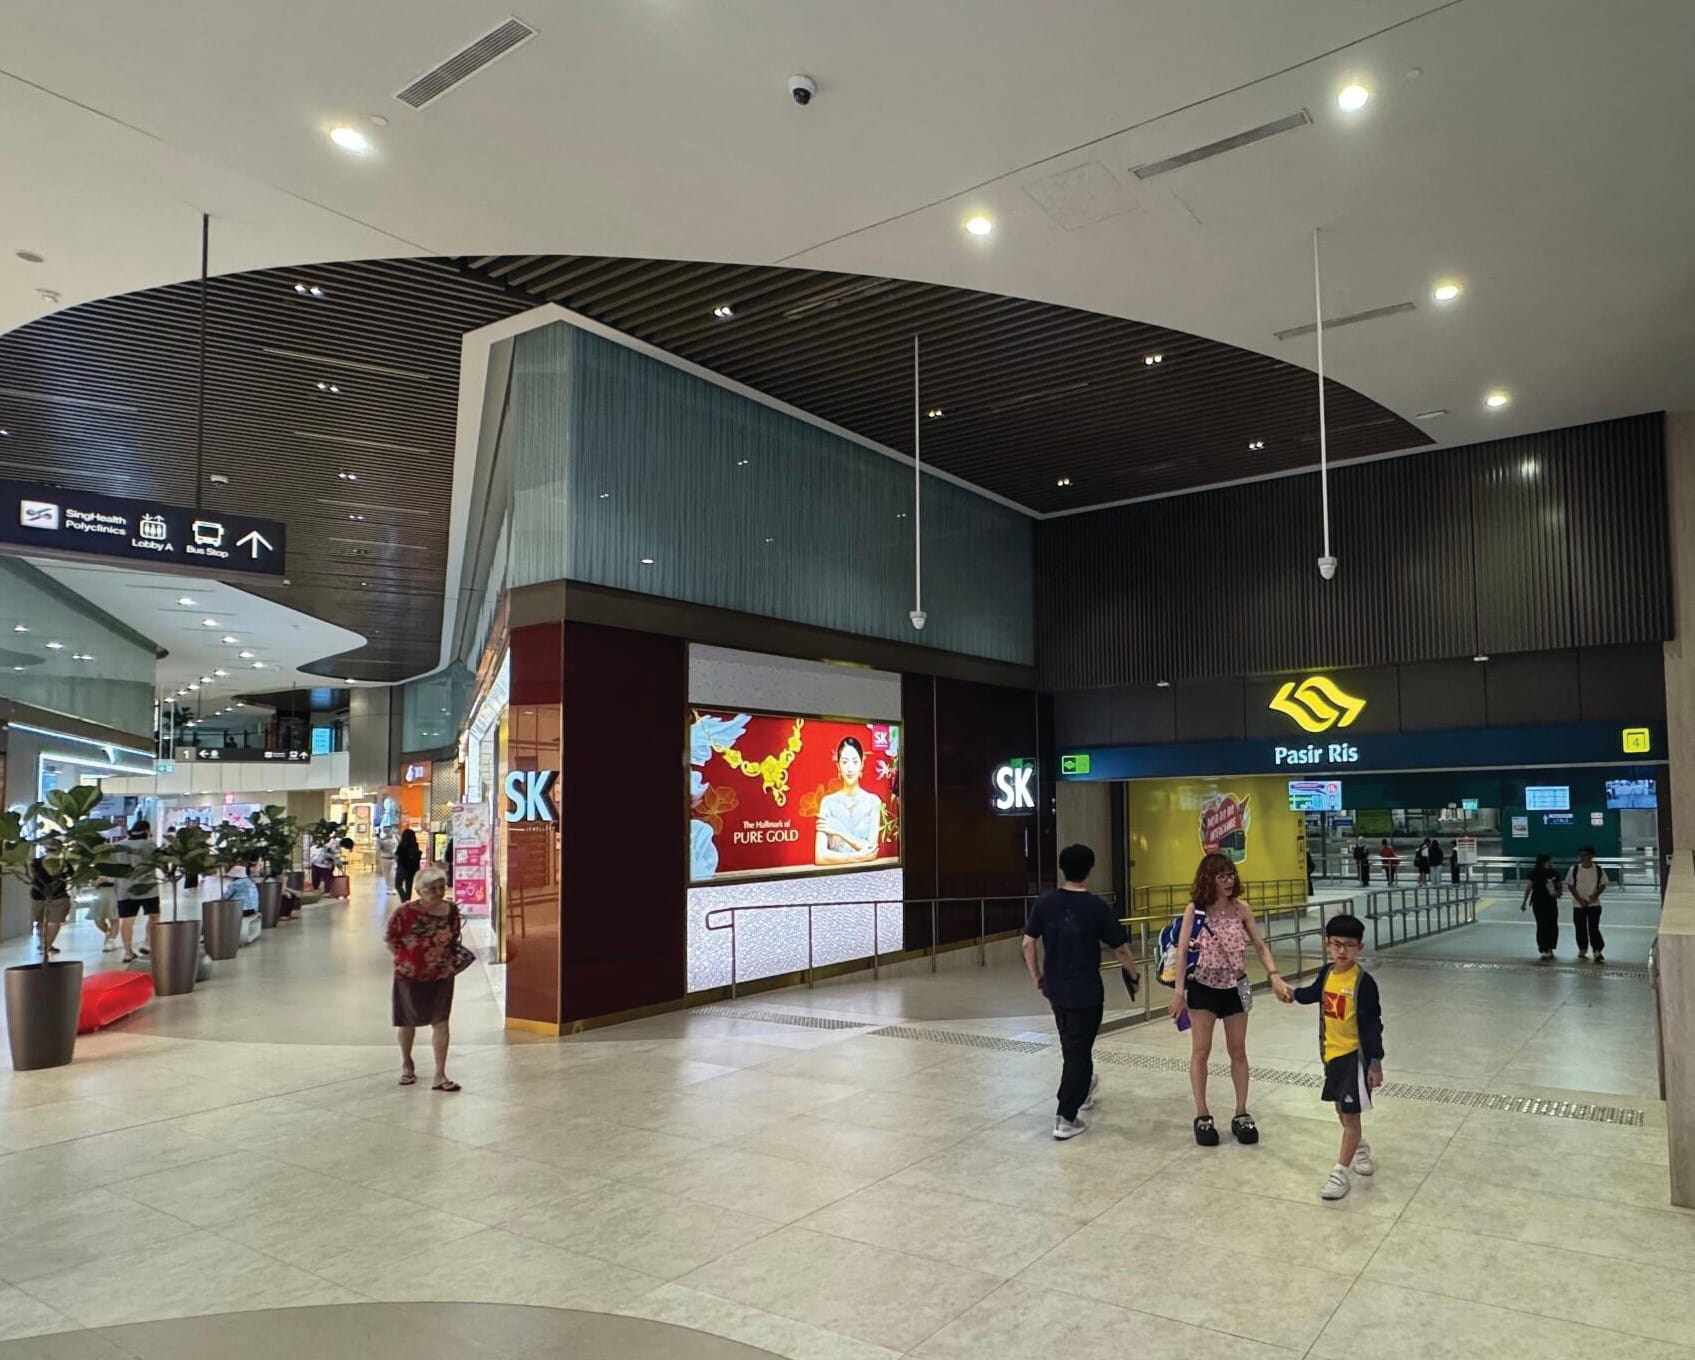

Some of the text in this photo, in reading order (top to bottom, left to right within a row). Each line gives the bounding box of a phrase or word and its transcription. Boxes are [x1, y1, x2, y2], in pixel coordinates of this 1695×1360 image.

[65, 508, 127, 525] SingHealth
[65, 520, 127, 535] Polyclinics
[131, 538, 174, 551] Lobby A
[186, 545, 229, 558] Bus Stop
[874, 731, 888, 745] SK
[183, 750, 190, 760] 1
[1274, 743, 1359, 765] Pasir Ris
[996, 766, 1035, 810] SK
[504, 770, 553, 822] SK
[743, 818, 791, 829] The Hallmark of
[733, 829, 799, 844] PURE GOLD
